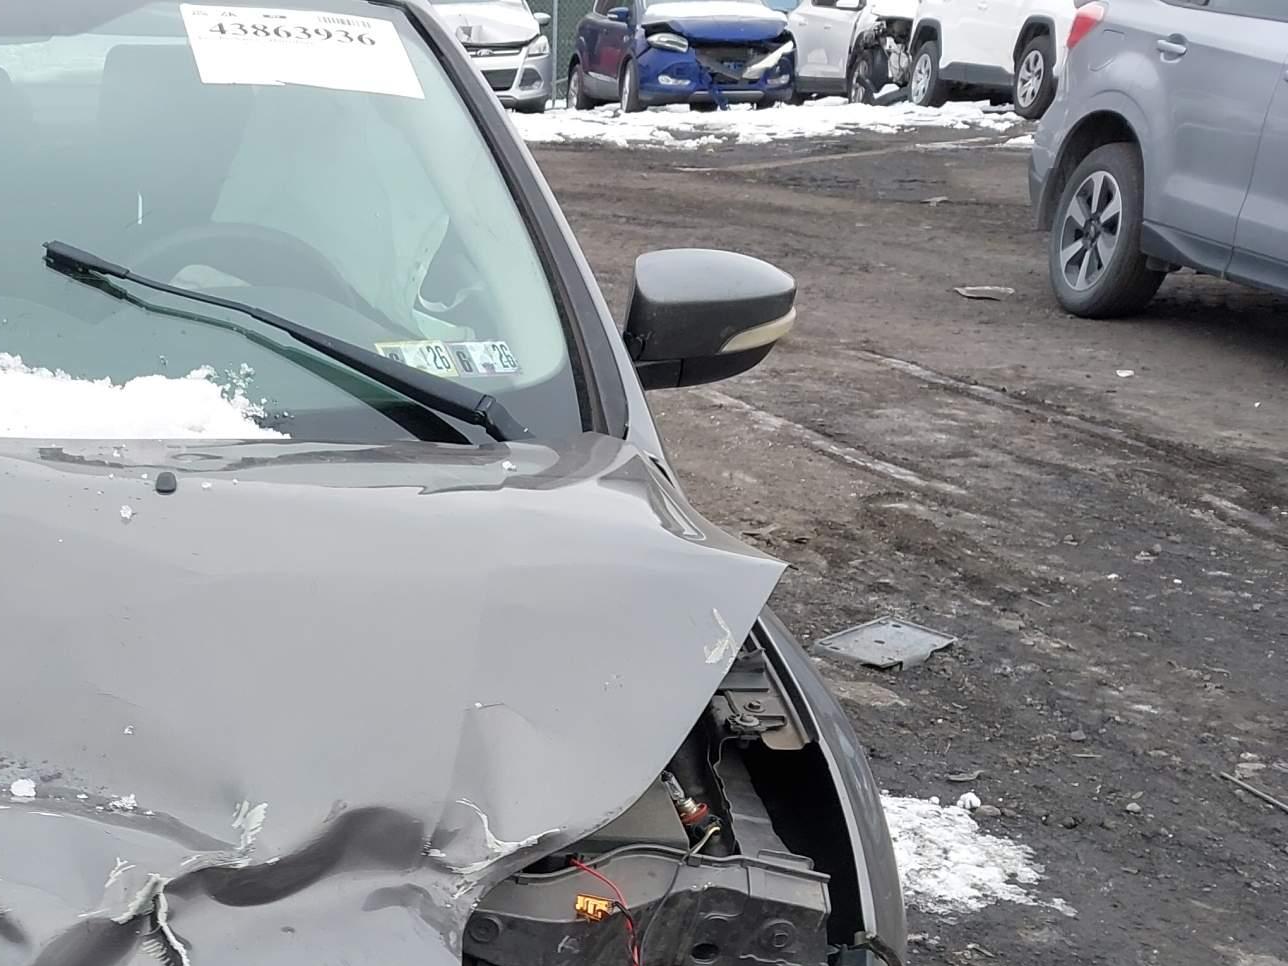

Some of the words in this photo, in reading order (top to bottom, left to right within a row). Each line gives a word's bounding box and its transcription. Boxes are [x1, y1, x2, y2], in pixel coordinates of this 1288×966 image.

[209, 22, 376, 46] 43863936
[426, 345, 451, 369] 26
[492, 344, 516, 368] 26
